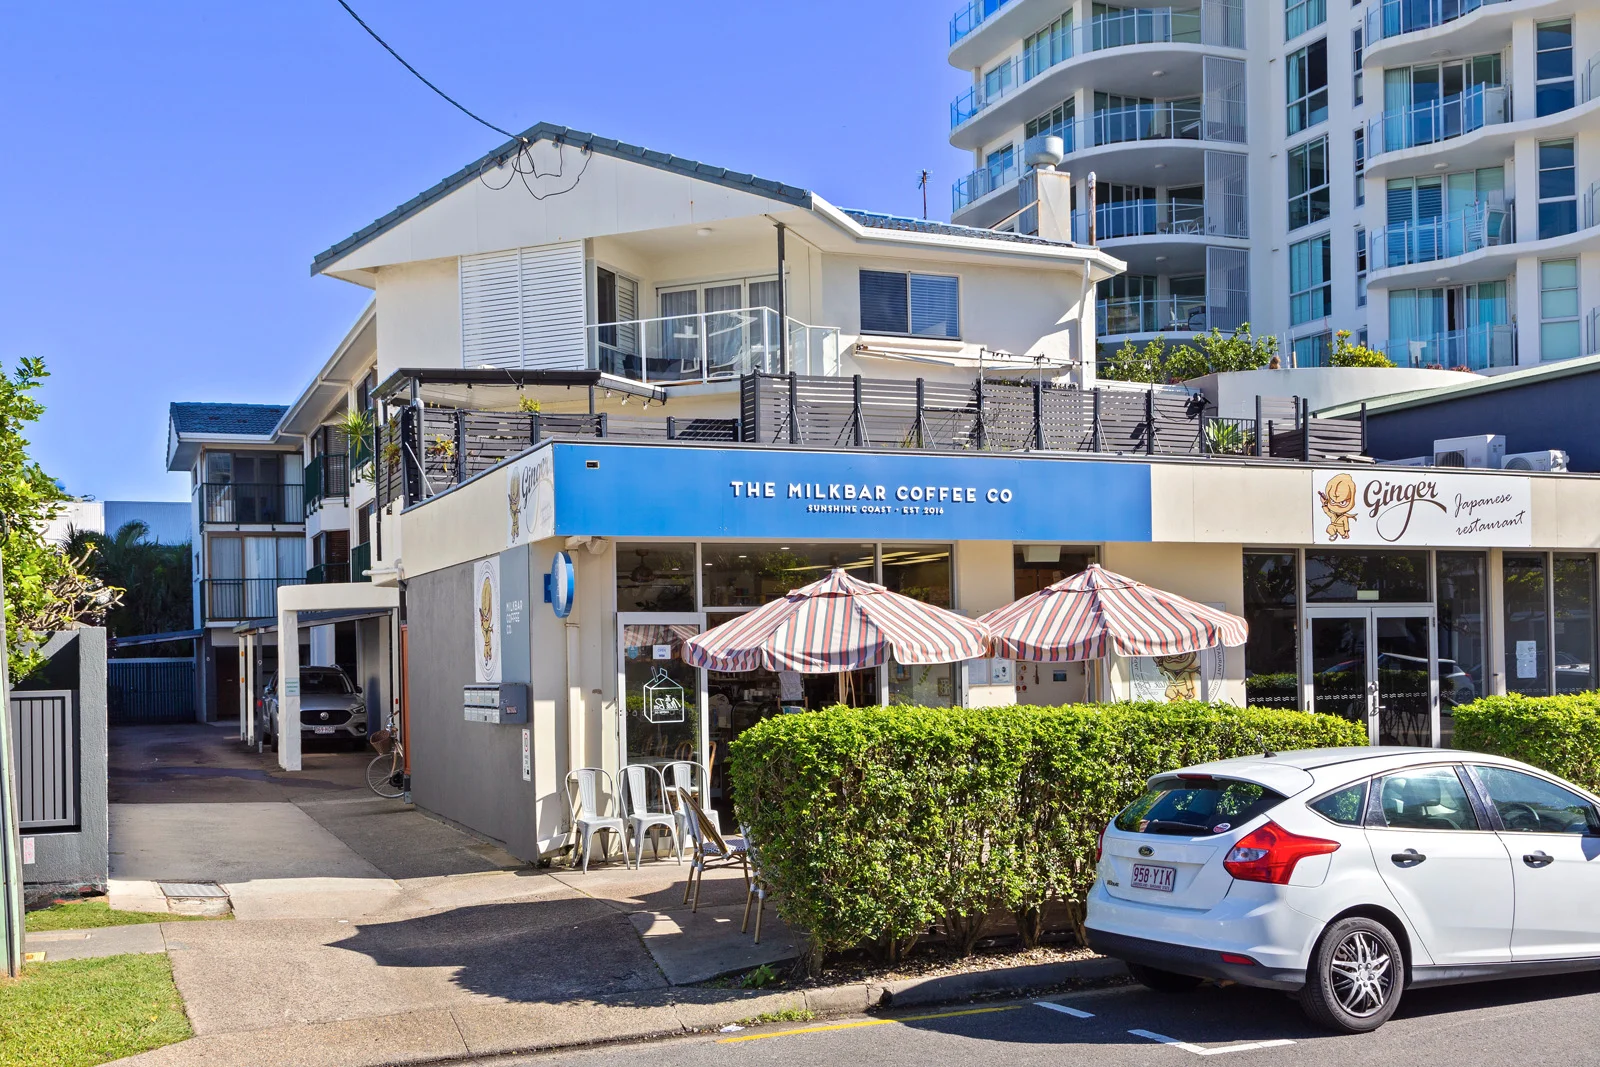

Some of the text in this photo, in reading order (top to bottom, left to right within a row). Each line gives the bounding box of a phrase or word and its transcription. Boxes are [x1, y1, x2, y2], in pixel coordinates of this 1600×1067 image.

[730, 481, 1013, 504] THE MILKBAR COFFEE CO
[807, 504, 857, 514] SUNSHINE
[861, 505, 891, 514] COAST
[902, 506, 920, 515] EST
[1363, 479, 1447, 542] Ginger
[1454, 493, 1512, 518] Japanese
[1456, 510, 1526, 536] restaurant
[1215, 645, 1223, 676] TAURANT
